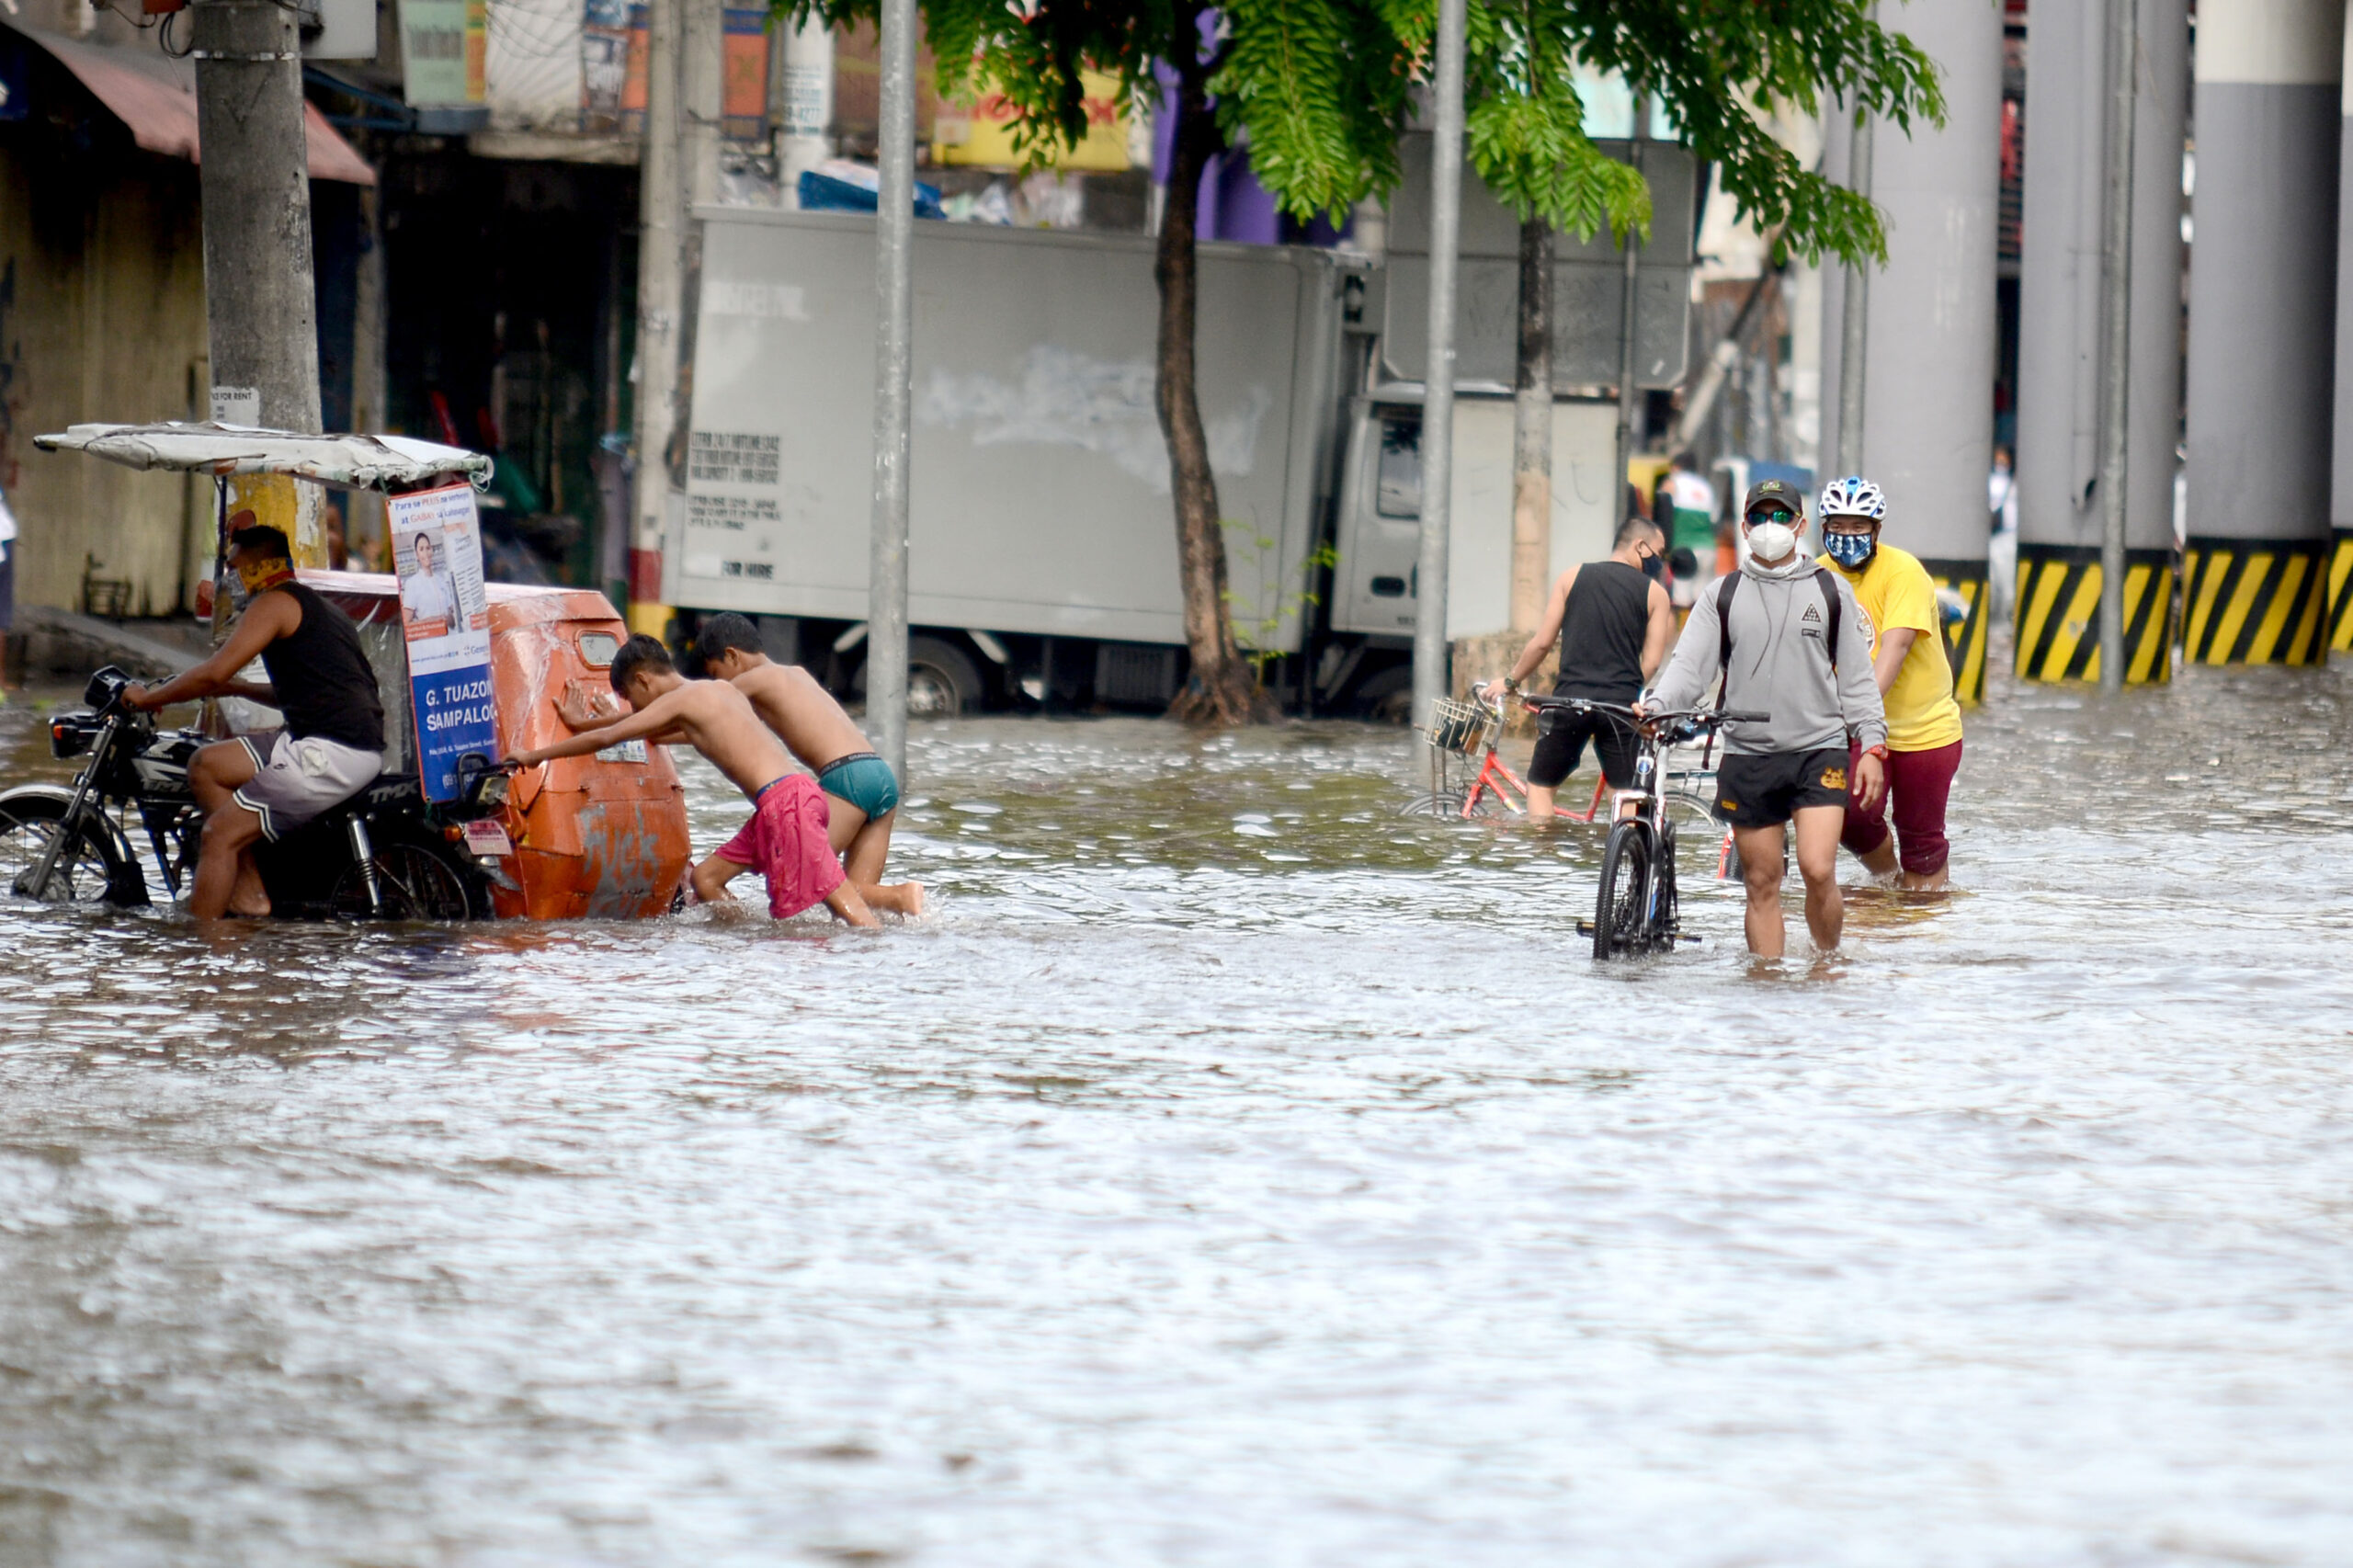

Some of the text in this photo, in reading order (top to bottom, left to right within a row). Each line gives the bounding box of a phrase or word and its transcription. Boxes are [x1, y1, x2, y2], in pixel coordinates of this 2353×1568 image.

[221, 392, 232, 401] FOR
[233, 392, 251, 401] RENT
[394, 502, 412, 511] Para
[422, 496, 439, 506] PLUS
[723, 561, 774, 580] FOR HIRE
[426, 680, 493, 707] G. TUAZON
[369, 781, 417, 804] TMX
